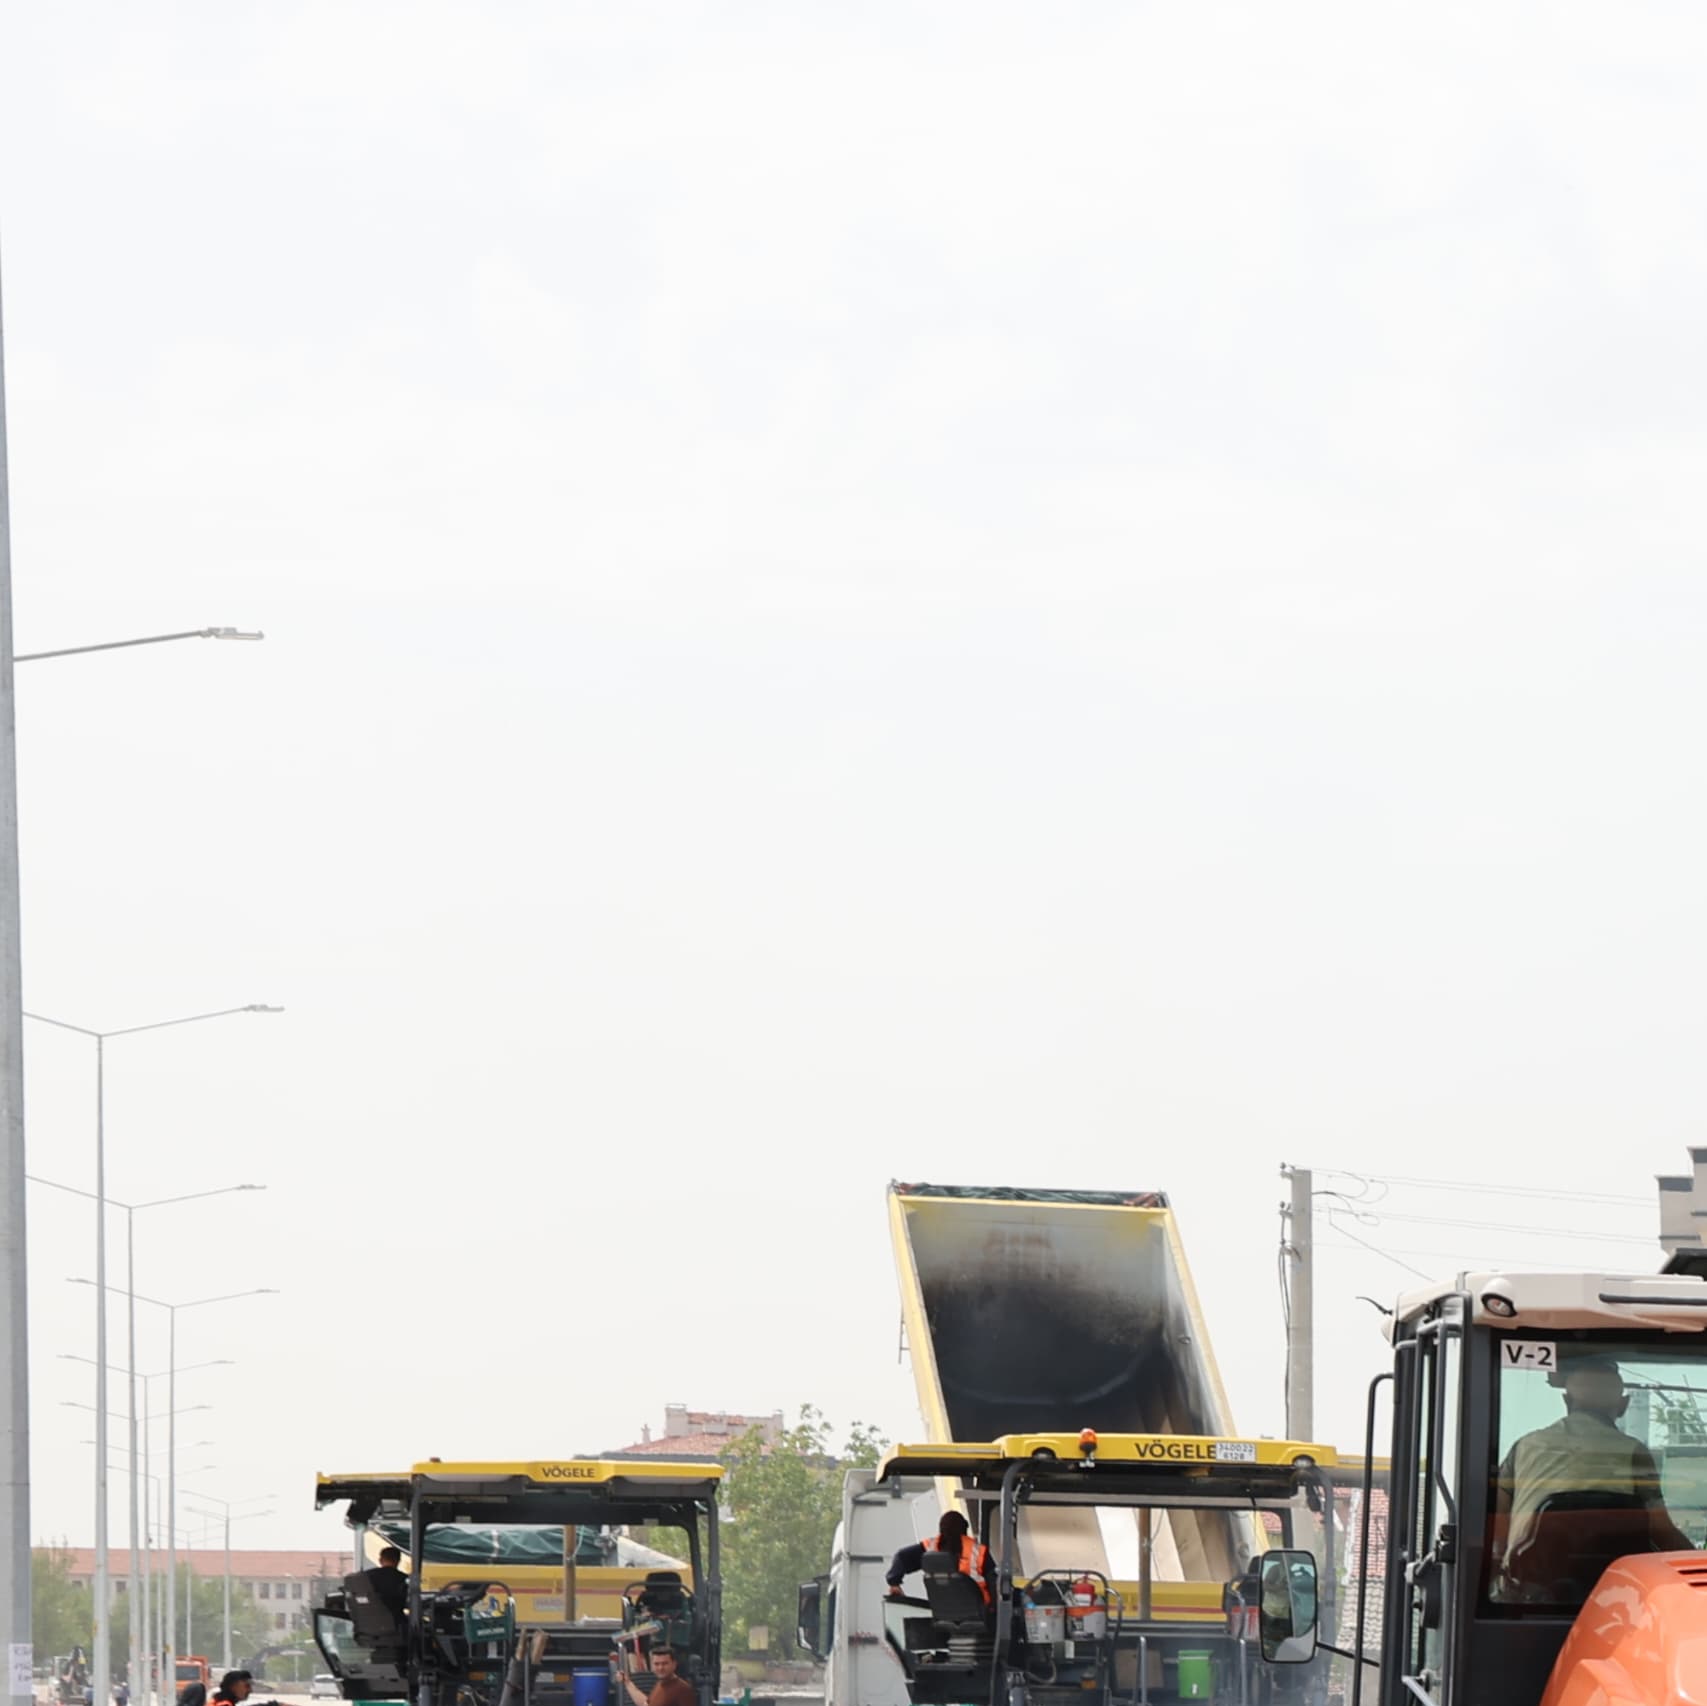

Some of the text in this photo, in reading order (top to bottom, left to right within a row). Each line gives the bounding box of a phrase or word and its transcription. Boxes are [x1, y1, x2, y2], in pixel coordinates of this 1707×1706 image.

[1505, 1343, 1553, 1367] V-2
[1133, 1438, 1218, 1460] VÖGELE
[541, 1464, 598, 1479] VÖGELE
